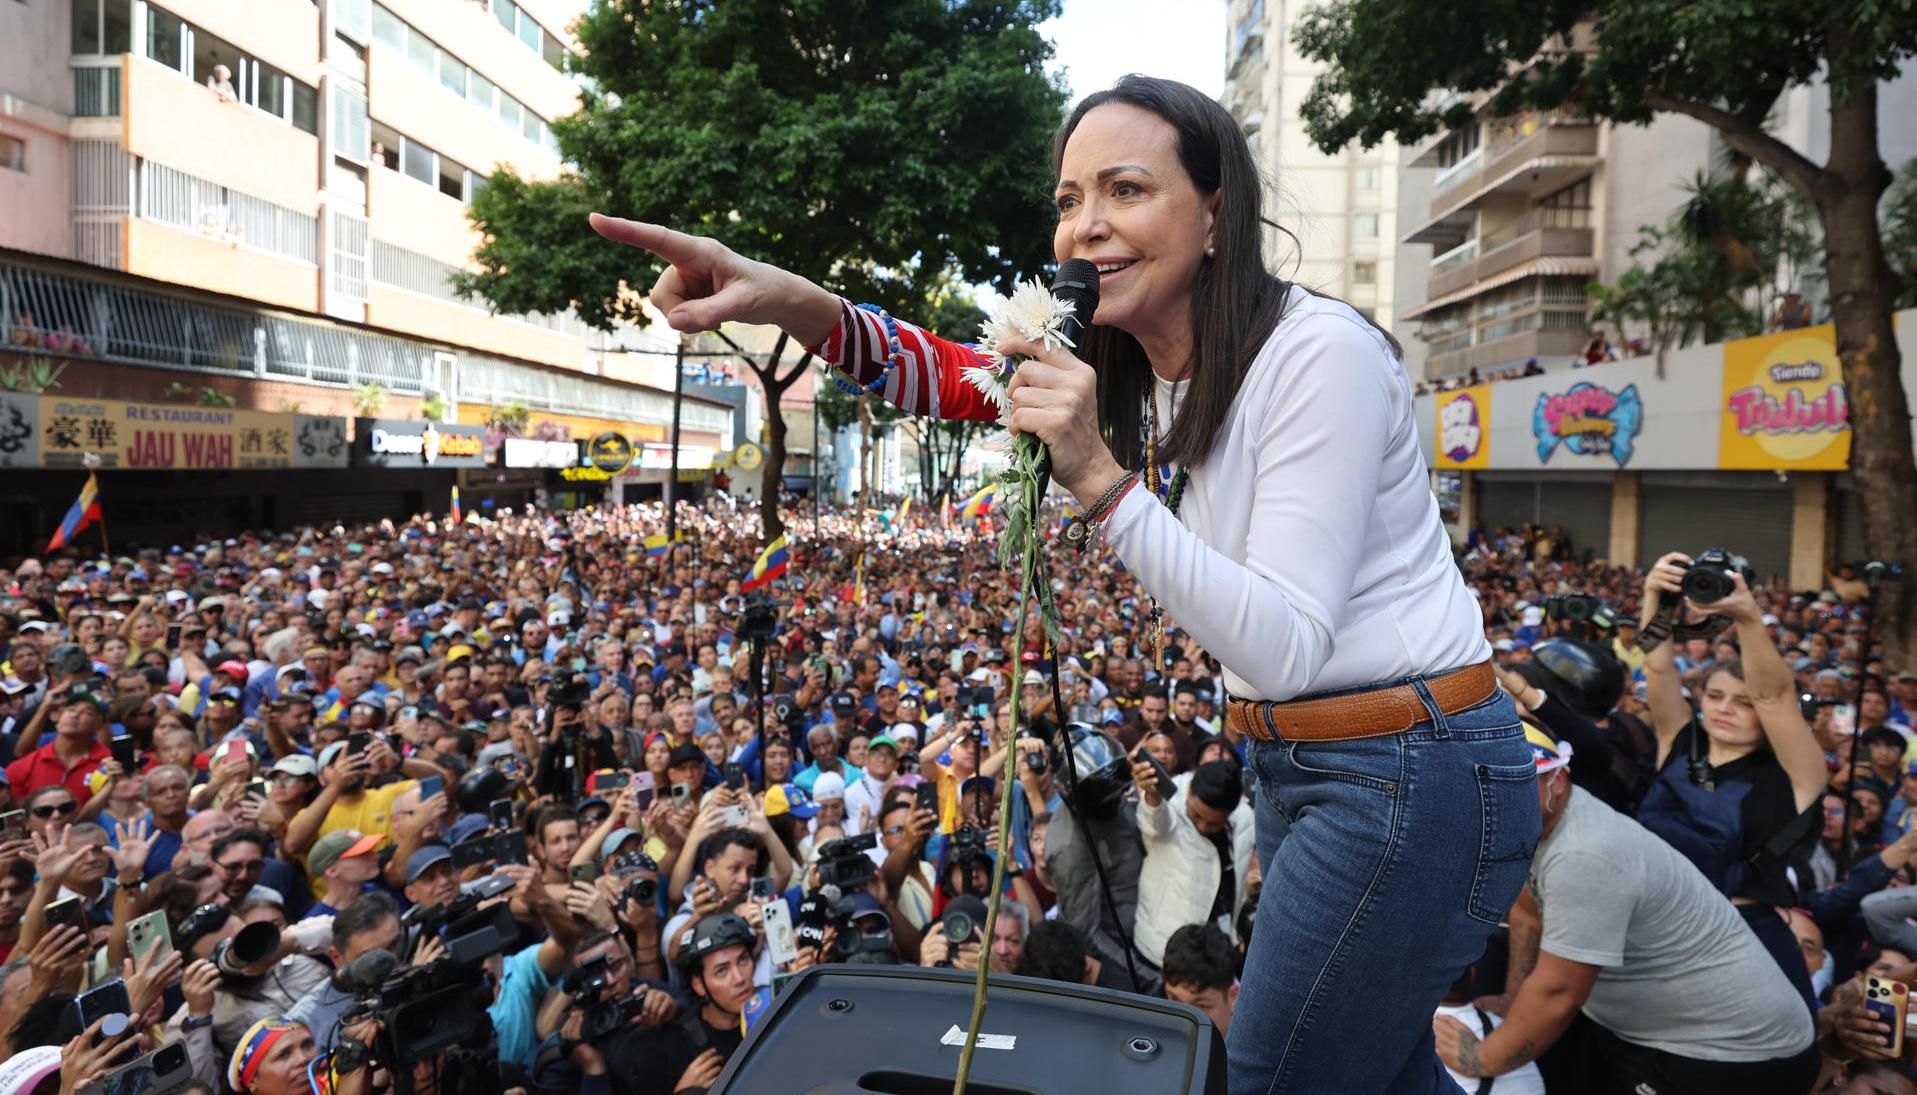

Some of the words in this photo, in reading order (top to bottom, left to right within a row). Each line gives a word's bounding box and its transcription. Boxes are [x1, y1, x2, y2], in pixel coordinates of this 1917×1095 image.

[126, 406, 234, 424] RESTAURANT
[127, 430, 175, 467] JAU
[182, 432, 232, 467] WAH
